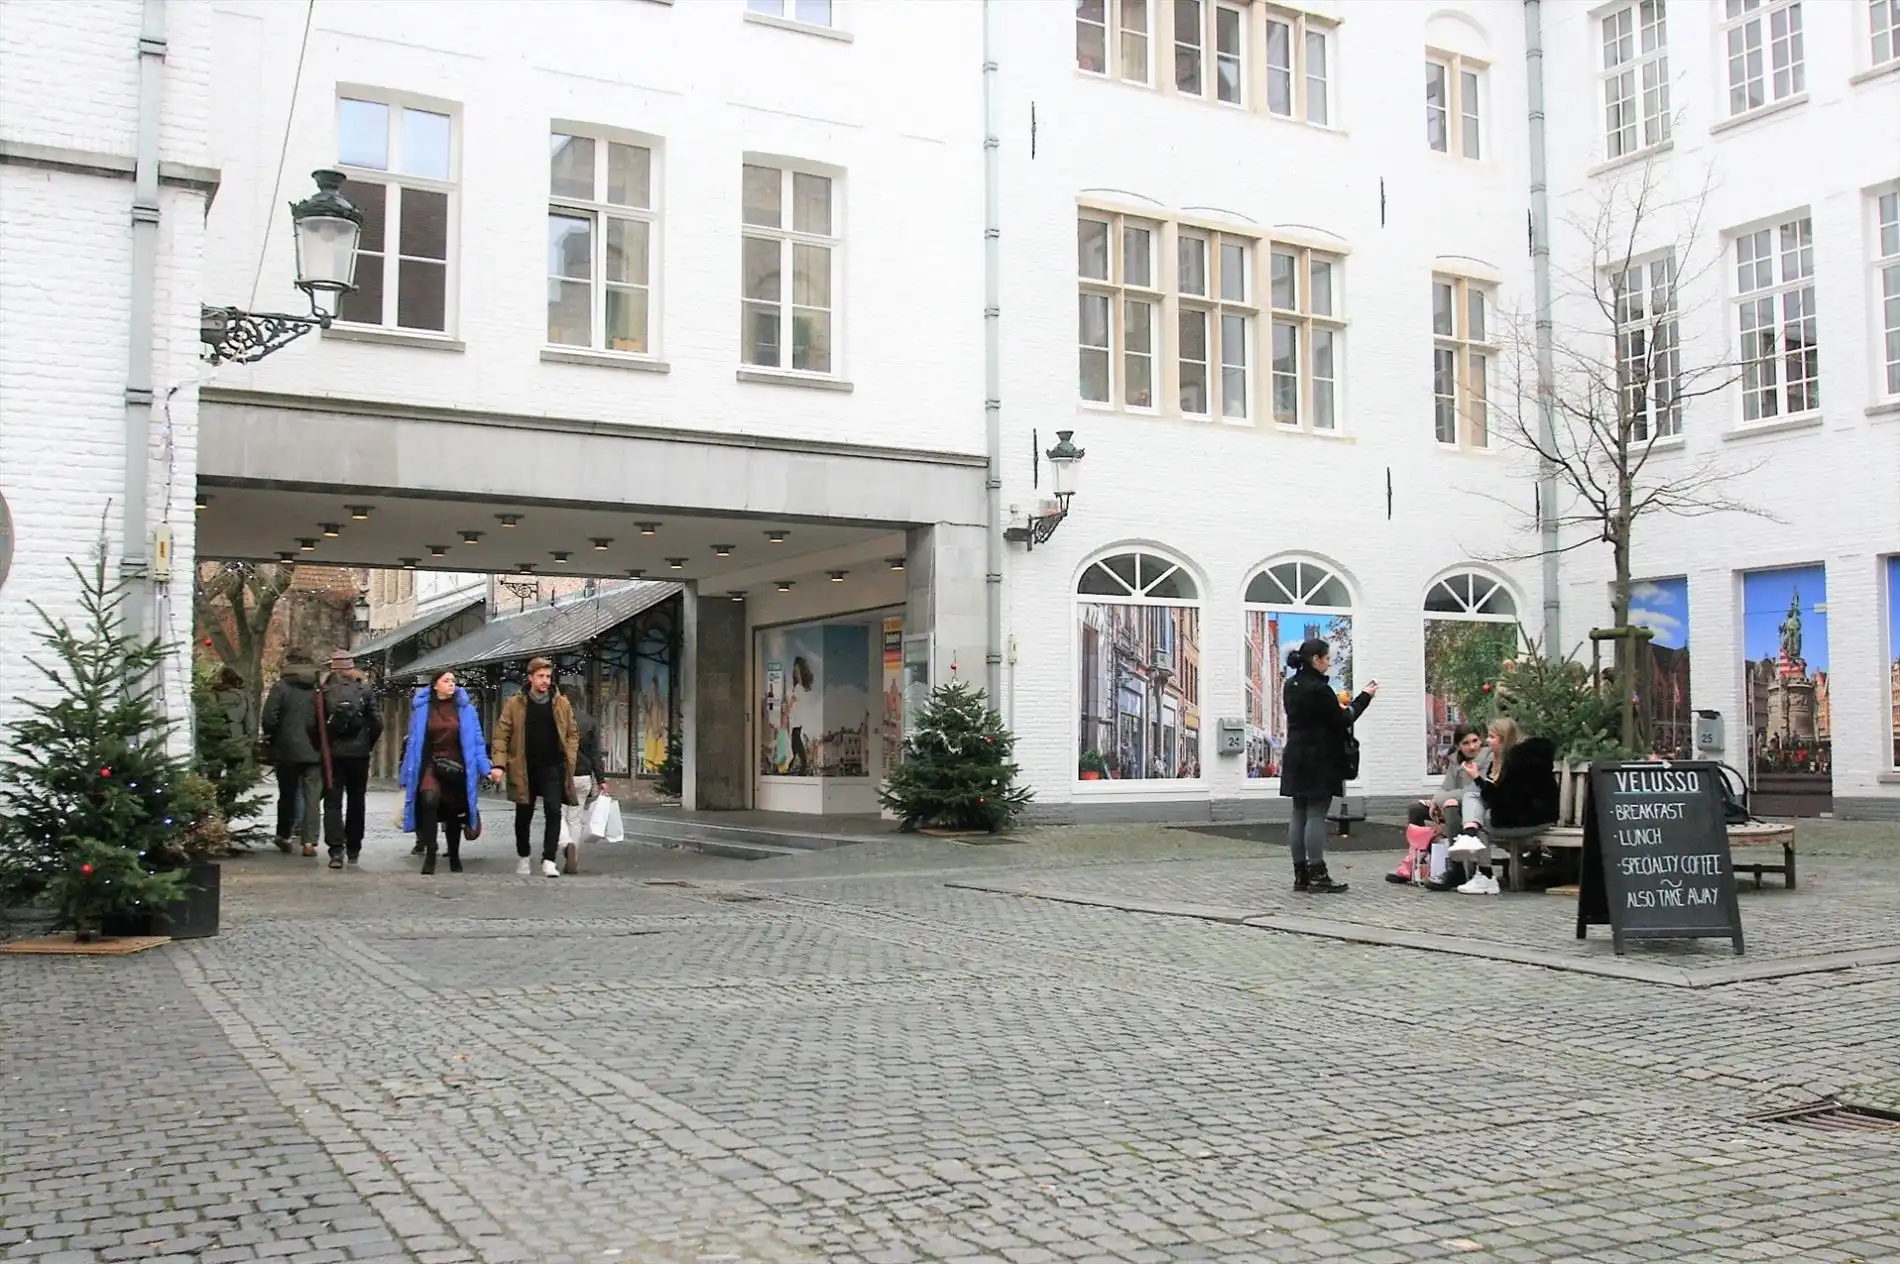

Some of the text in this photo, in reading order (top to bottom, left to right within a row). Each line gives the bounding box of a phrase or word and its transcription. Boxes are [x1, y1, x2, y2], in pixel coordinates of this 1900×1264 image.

[1228, 736, 1240, 748] 24
[1701, 733, 1712, 744] 25
[1614, 771, 1700, 793] VELUSSO
[1615, 803, 1686, 820] BREAKFAST
[1618, 827, 1662, 847] LUNCH
[1621, 854, 1723, 875] SPECIALTY COFFEE
[1626, 887, 1718, 908] ALSO TAKE AWAY
